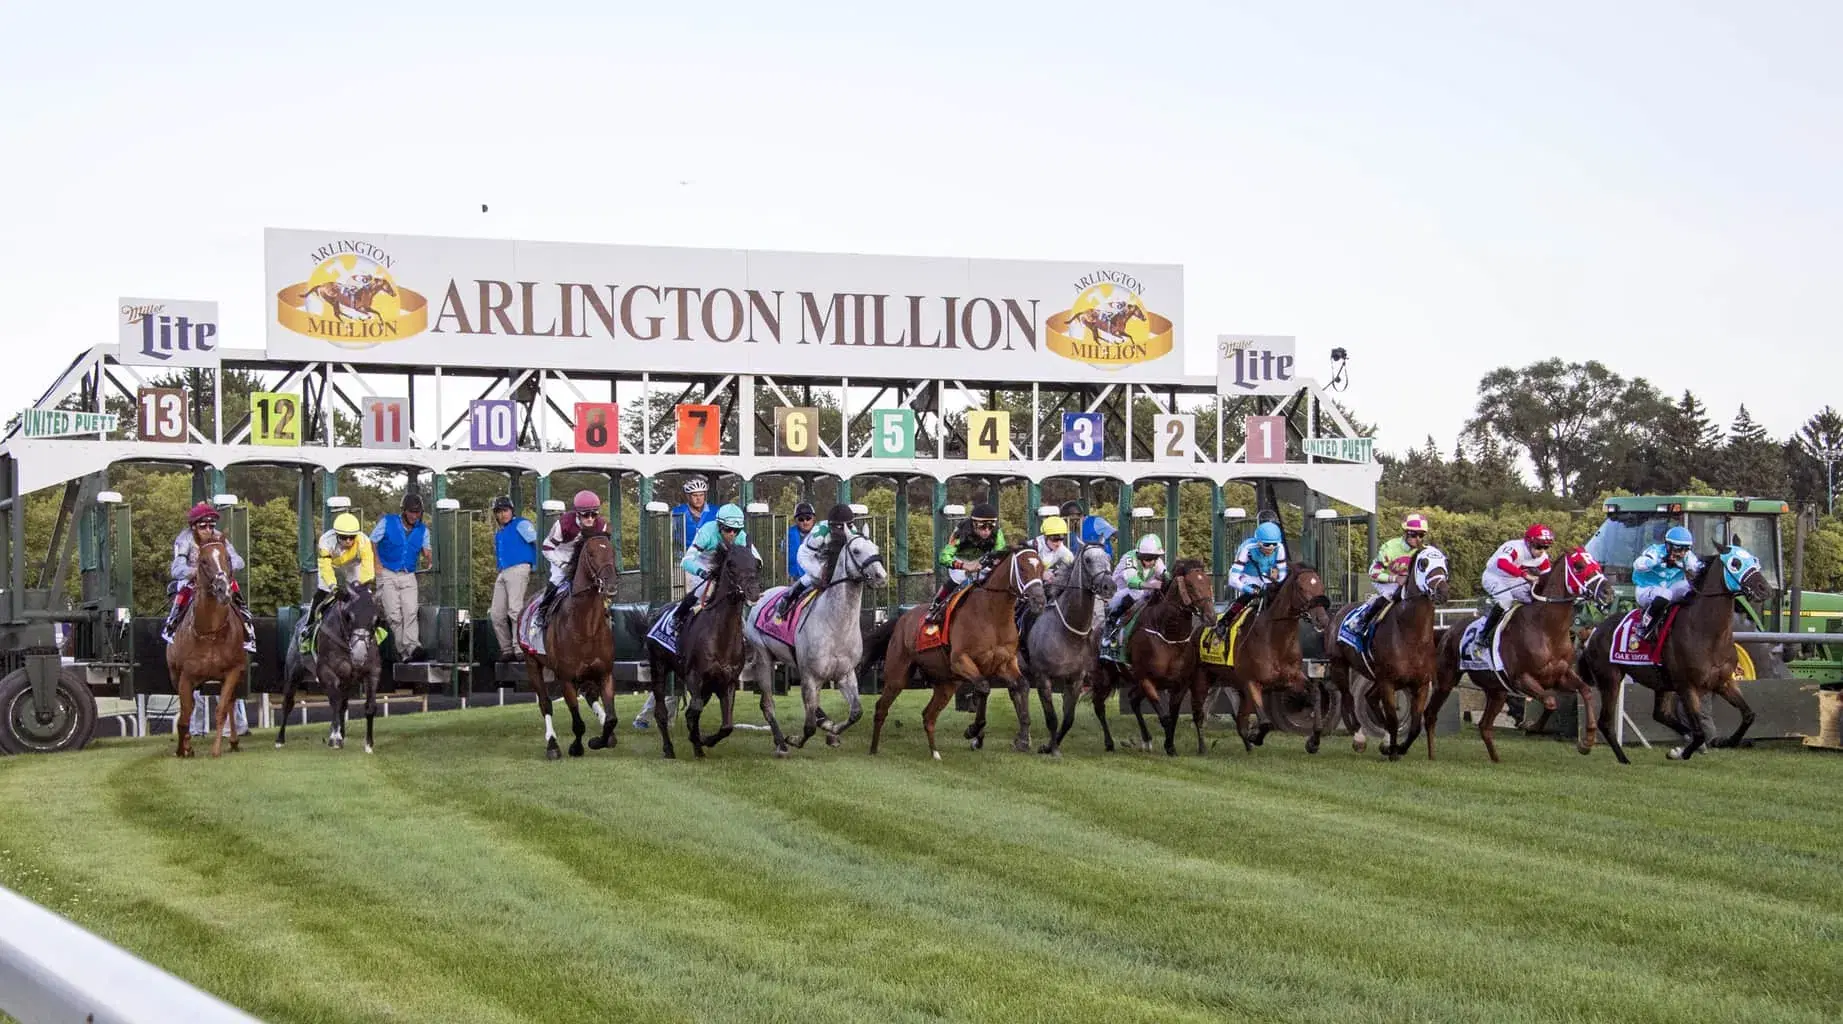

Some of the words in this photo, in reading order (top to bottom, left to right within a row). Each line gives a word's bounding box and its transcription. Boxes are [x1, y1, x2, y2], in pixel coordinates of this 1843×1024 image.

[311, 240, 397, 268] ARLINGTON
[1073, 270, 1145, 295] ARLINGTON
[121, 304, 164, 322] Miller
[308, 317, 398, 337] MILLION
[430, 277, 784, 344] ARLINGTON
[796, 291, 1040, 352] MILLION
[139, 313, 216, 360] Lite
[1071, 342, 1147, 360] MILLION
[1232, 348, 1293, 390] Lite
[24, 408, 69, 436] UNITED
[75, 414, 115, 432] PUETT
[142, 394, 182, 438] 13
[256, 398, 295, 440] 12
[370, 402, 400, 442] 11
[474, 405, 512, 447] 10
[586, 407, 608, 448] 8
[688, 410, 709, 449] 7
[785, 412, 808, 453] 6
[883, 414, 905, 453] 5
[978, 416, 999, 454] 4
[1072, 418, 1093, 457] 3
[1166, 420, 1184, 457] 2
[1259, 421, 1272, 459] 1
[1304, 440, 1337, 456] UNITED
[1342, 439, 1372, 463] PUETT
[1462, 628, 1477, 660] 2
[1620, 618, 1633, 652] 1
